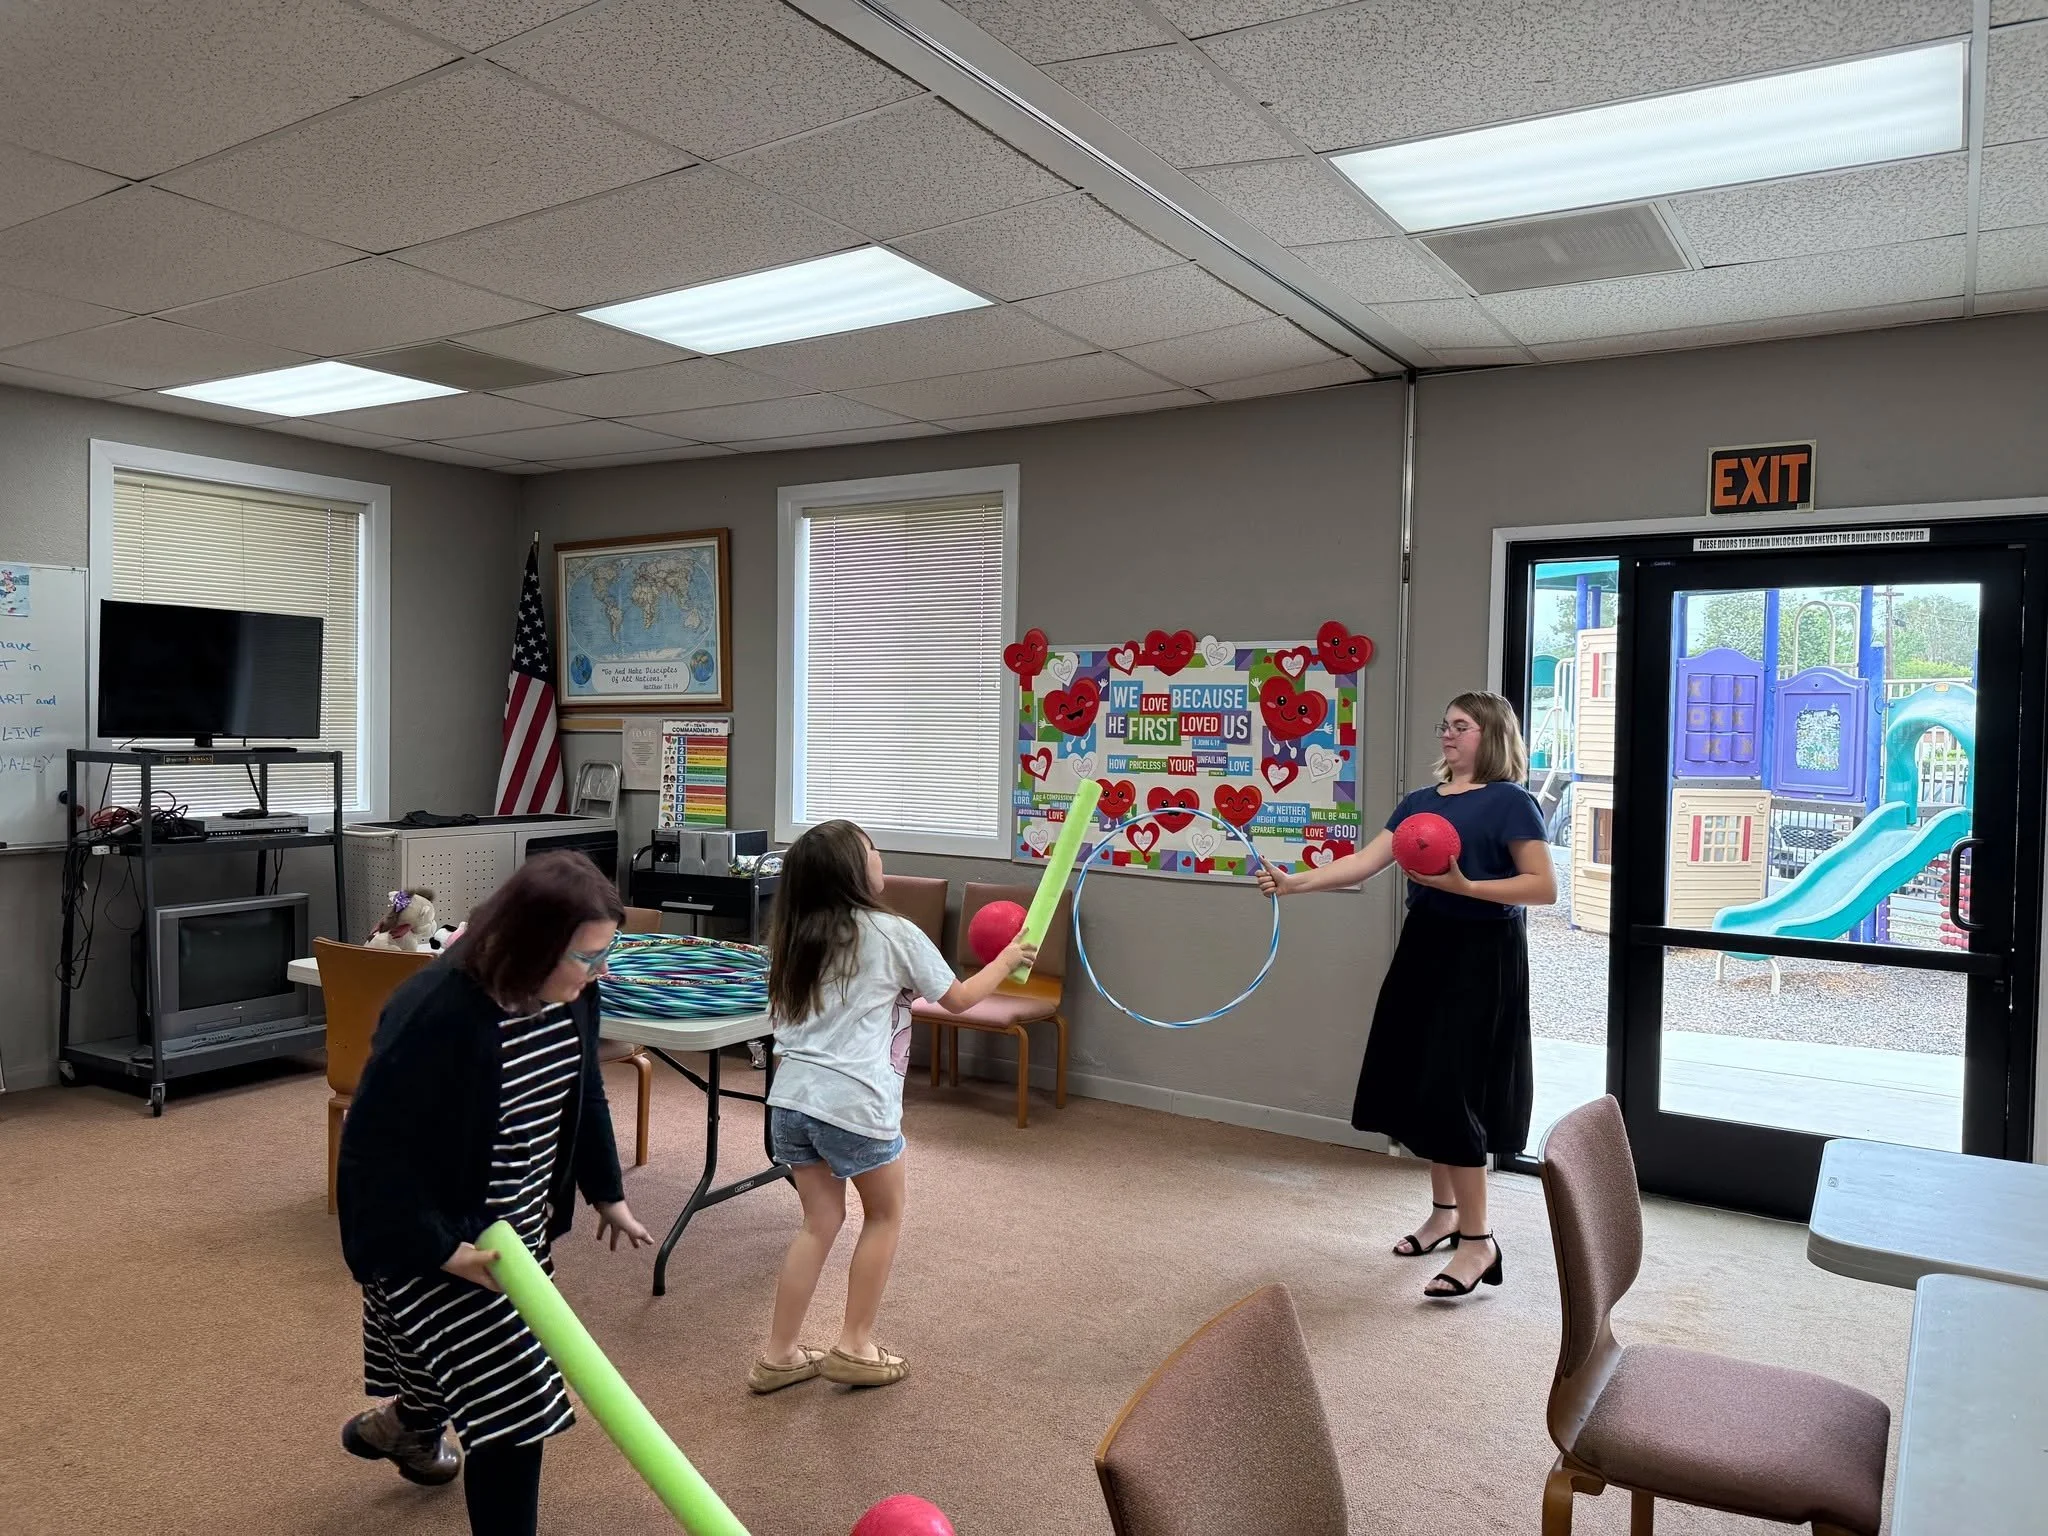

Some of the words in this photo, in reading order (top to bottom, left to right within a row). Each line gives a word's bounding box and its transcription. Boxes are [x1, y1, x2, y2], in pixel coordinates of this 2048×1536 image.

[1714, 453, 1808, 507] EXIT
[1699, 540, 1717, 549] THESE
[1718, 539, 1738, 549] DOORS
[1739, 539, 1747, 548] TO
[1747, 538, 1771, 548] REMAIN
[1772, 536, 1803, 547] UNLOCKED
[1804, 534, 1838, 545] WHENEVER
[1839, 533, 1850, 543] THE
[1851, 532, 1882, 543] BUILDING
[1883, 532, 1890, 541] IS
[1891, 530, 1924, 541] OCCUPIED
[29, 663, 41, 671] in
[645, 665, 679, 675] Disciples
[36, 695, 56, 705] and
[1113, 686, 1138, 708] WE
[1142, 697, 1168, 712] LOVE
[1172, 688, 1243, 709] BECAUSE
[1108, 716, 1125, 734] HE
[1128, 717, 1177, 741] FIRST
[1181, 716, 1218, 733] LOVED
[1223, 715, 1248, 739] US
[679, 747, 685, 755] 2
[1109, 758, 1126, 769] HOW
[1129, 760, 1161, 770] PRICELESS
[1169, 759, 1195, 773] YOUR
[1197, 755, 1227, 765] UNFAILING
[1229, 760, 1250, 772] LOVE
[677, 804, 683, 812] 8
[1276, 805, 1307, 816] NEITHER
[1048, 810, 1064, 820] LOVE
[1256, 815, 1277, 824] HEIGHT
[1290, 816, 1307, 824] DEPTH
[1311, 811, 1327, 820] WILL
[1328, 812, 1337, 820] BE
[1338, 812, 1350, 820] ABLE
[1351, 812, 1358, 820] TO
[1250, 825, 1276, 834] SEPARATE
[1305, 828, 1324, 838] LOVE
[1334, 824, 1357, 839] GOD
